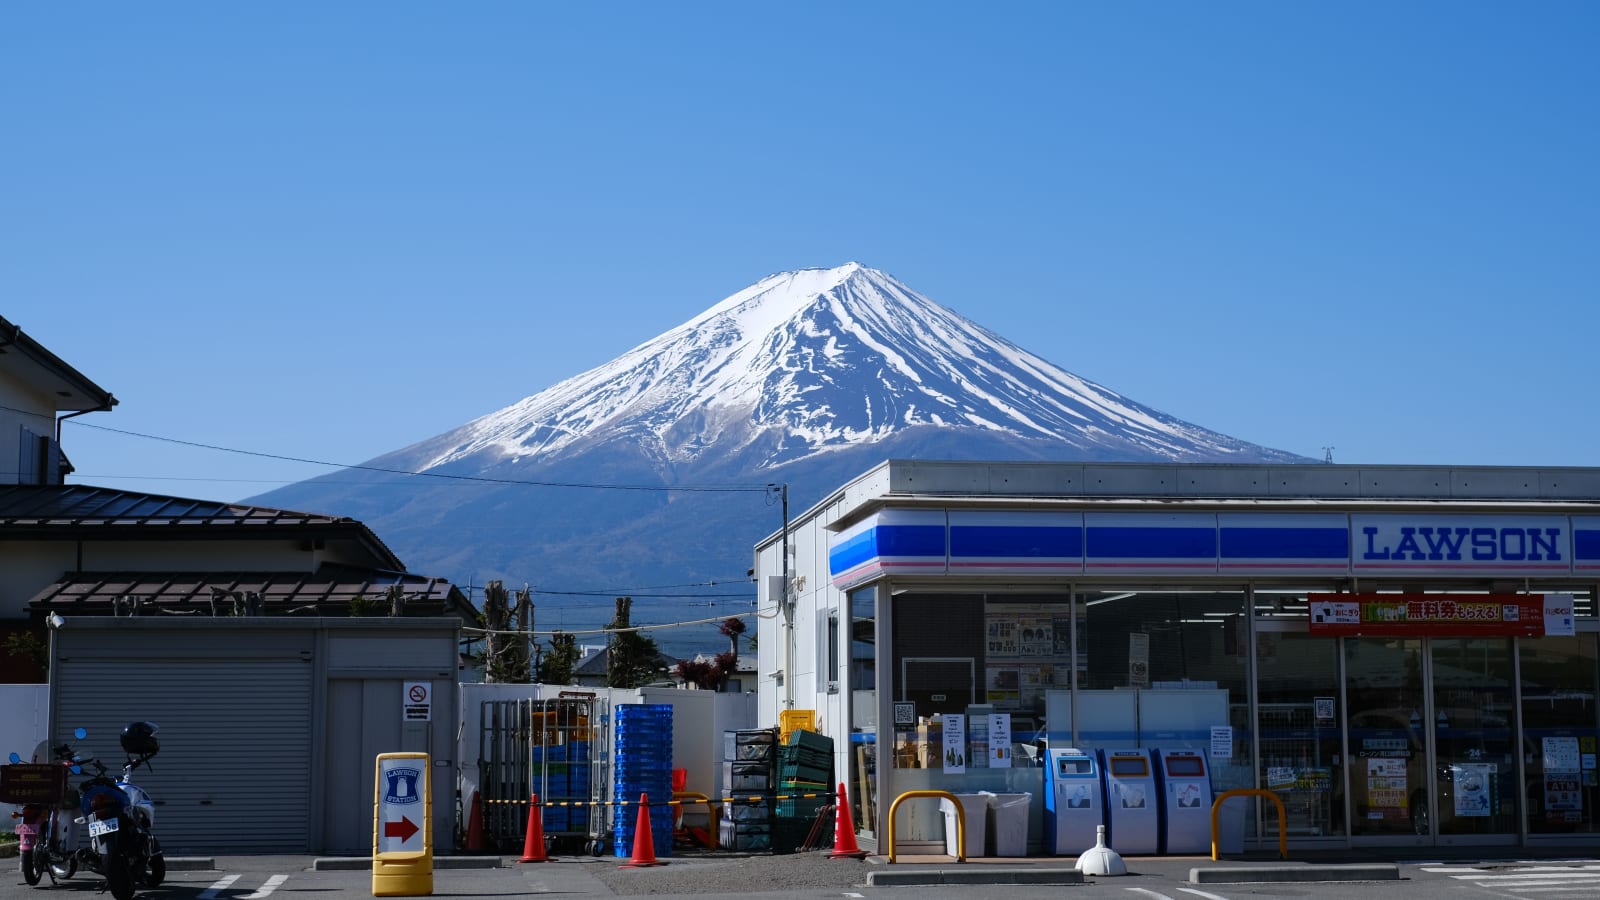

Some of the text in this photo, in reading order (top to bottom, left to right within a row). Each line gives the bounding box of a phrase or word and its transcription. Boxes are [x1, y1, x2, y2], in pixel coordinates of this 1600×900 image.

[1363, 527, 1561, 561] LAWSON
[388, 769, 417, 778] LAWSON
[1552, 782, 1575, 791] ATM
[388, 795, 416, 803] STATION
